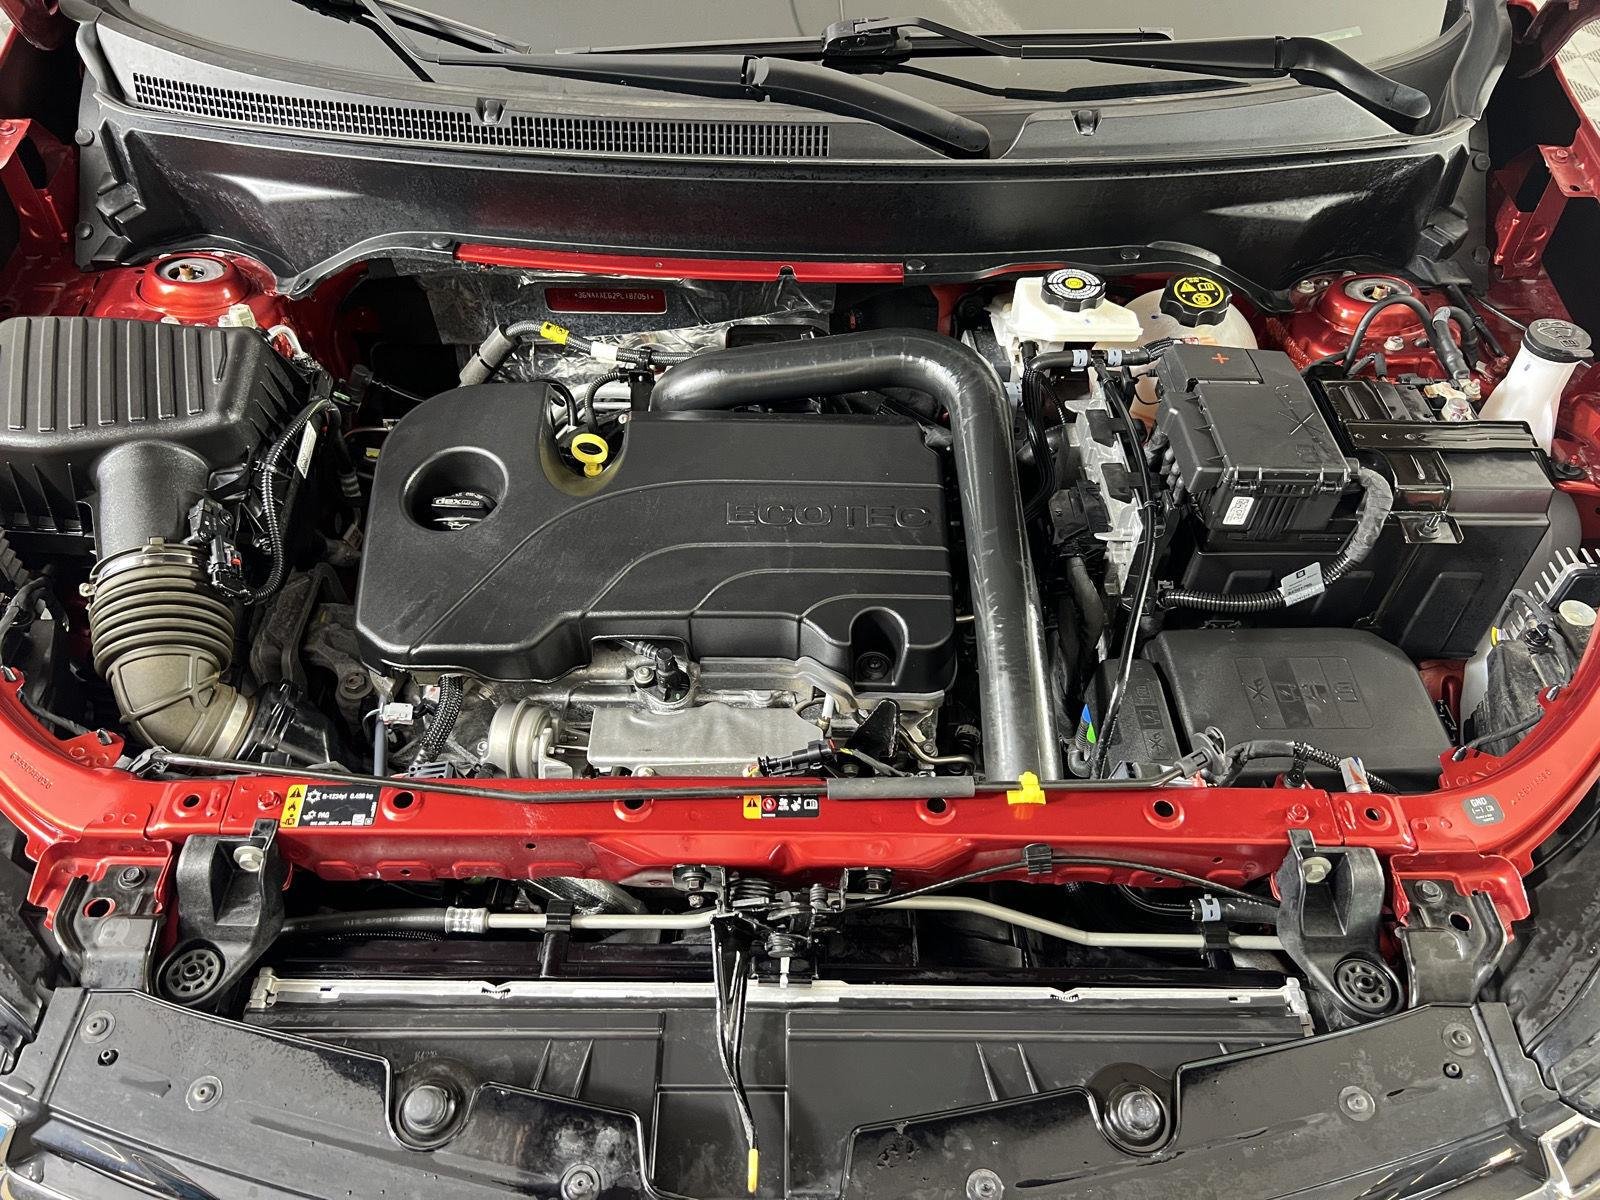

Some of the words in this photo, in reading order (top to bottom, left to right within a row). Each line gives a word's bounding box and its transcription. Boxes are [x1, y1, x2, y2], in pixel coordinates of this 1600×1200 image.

[725, 500, 932, 529] ECOTEC
[1469, 796, 1488, 807] GND
[317, 811, 330, 819] PAG
